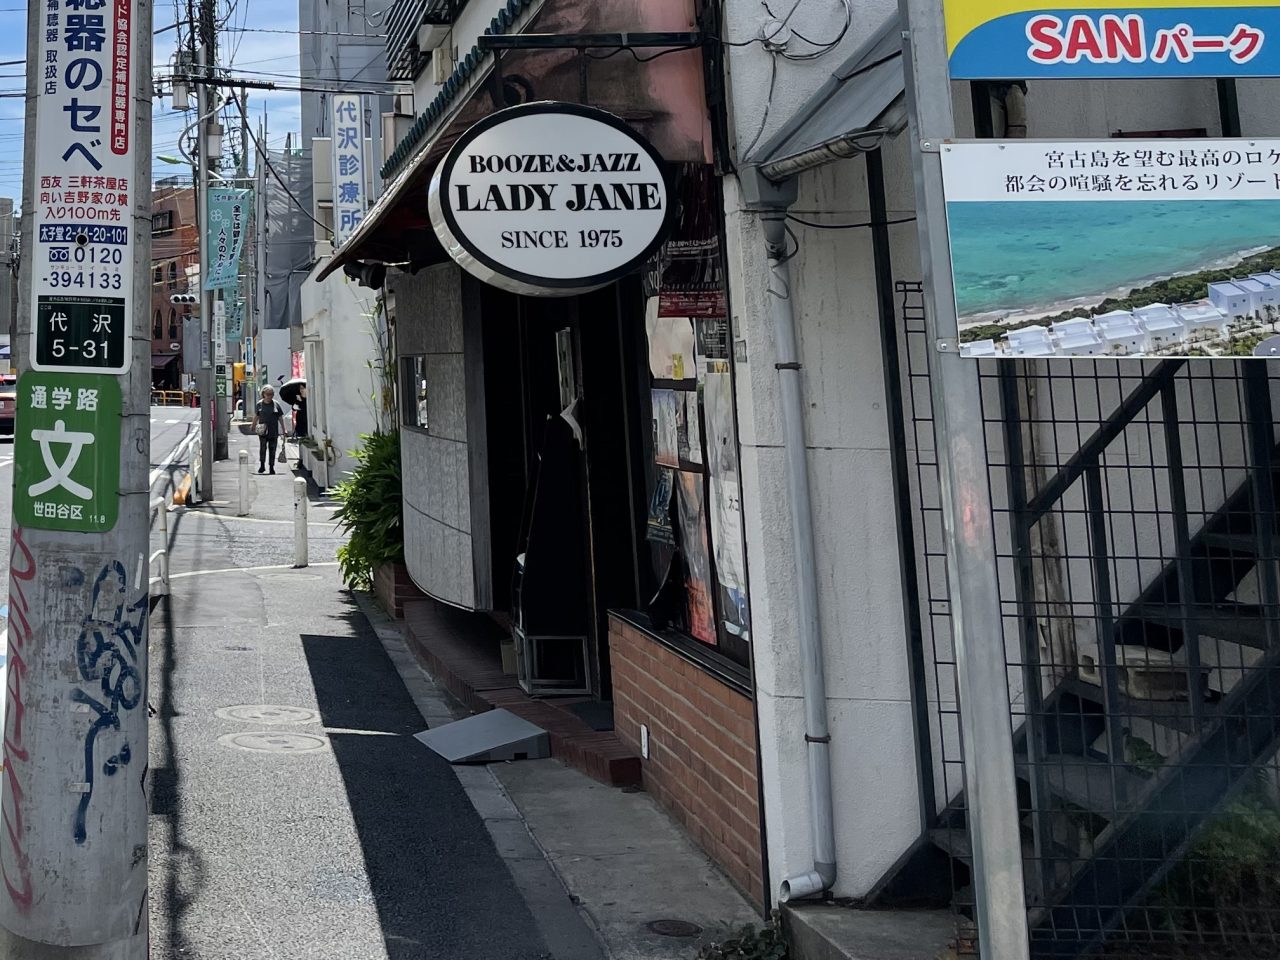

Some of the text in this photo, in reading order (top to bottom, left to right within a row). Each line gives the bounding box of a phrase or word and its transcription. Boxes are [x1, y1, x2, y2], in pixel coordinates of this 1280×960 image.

[44, 49, 58, 95] 取扱店
[335, 100, 363, 232] 代沢診療所
[468, 152, 641, 174] BOOZE&JAZZ
[40, 175, 128, 191] 西友 三軒茶屋店
[40, 191, 129, 207] 向い吉野家の横
[454, 182, 662, 212] LADY JANE
[45, 206, 121, 221] 入り100m先
[501, 229, 623, 249] SINCE 1975
[74, 246, 122, 265] 0120
[43, 271, 122, 289] -394133
[52, 339, 109, 359] 5-31
[31, 385, 98, 412] 通学路
[28, 419, 95, 500] 文
[33, 501, 83, 520] 世田谷区
[89, 515, 106, 524] 11.8
